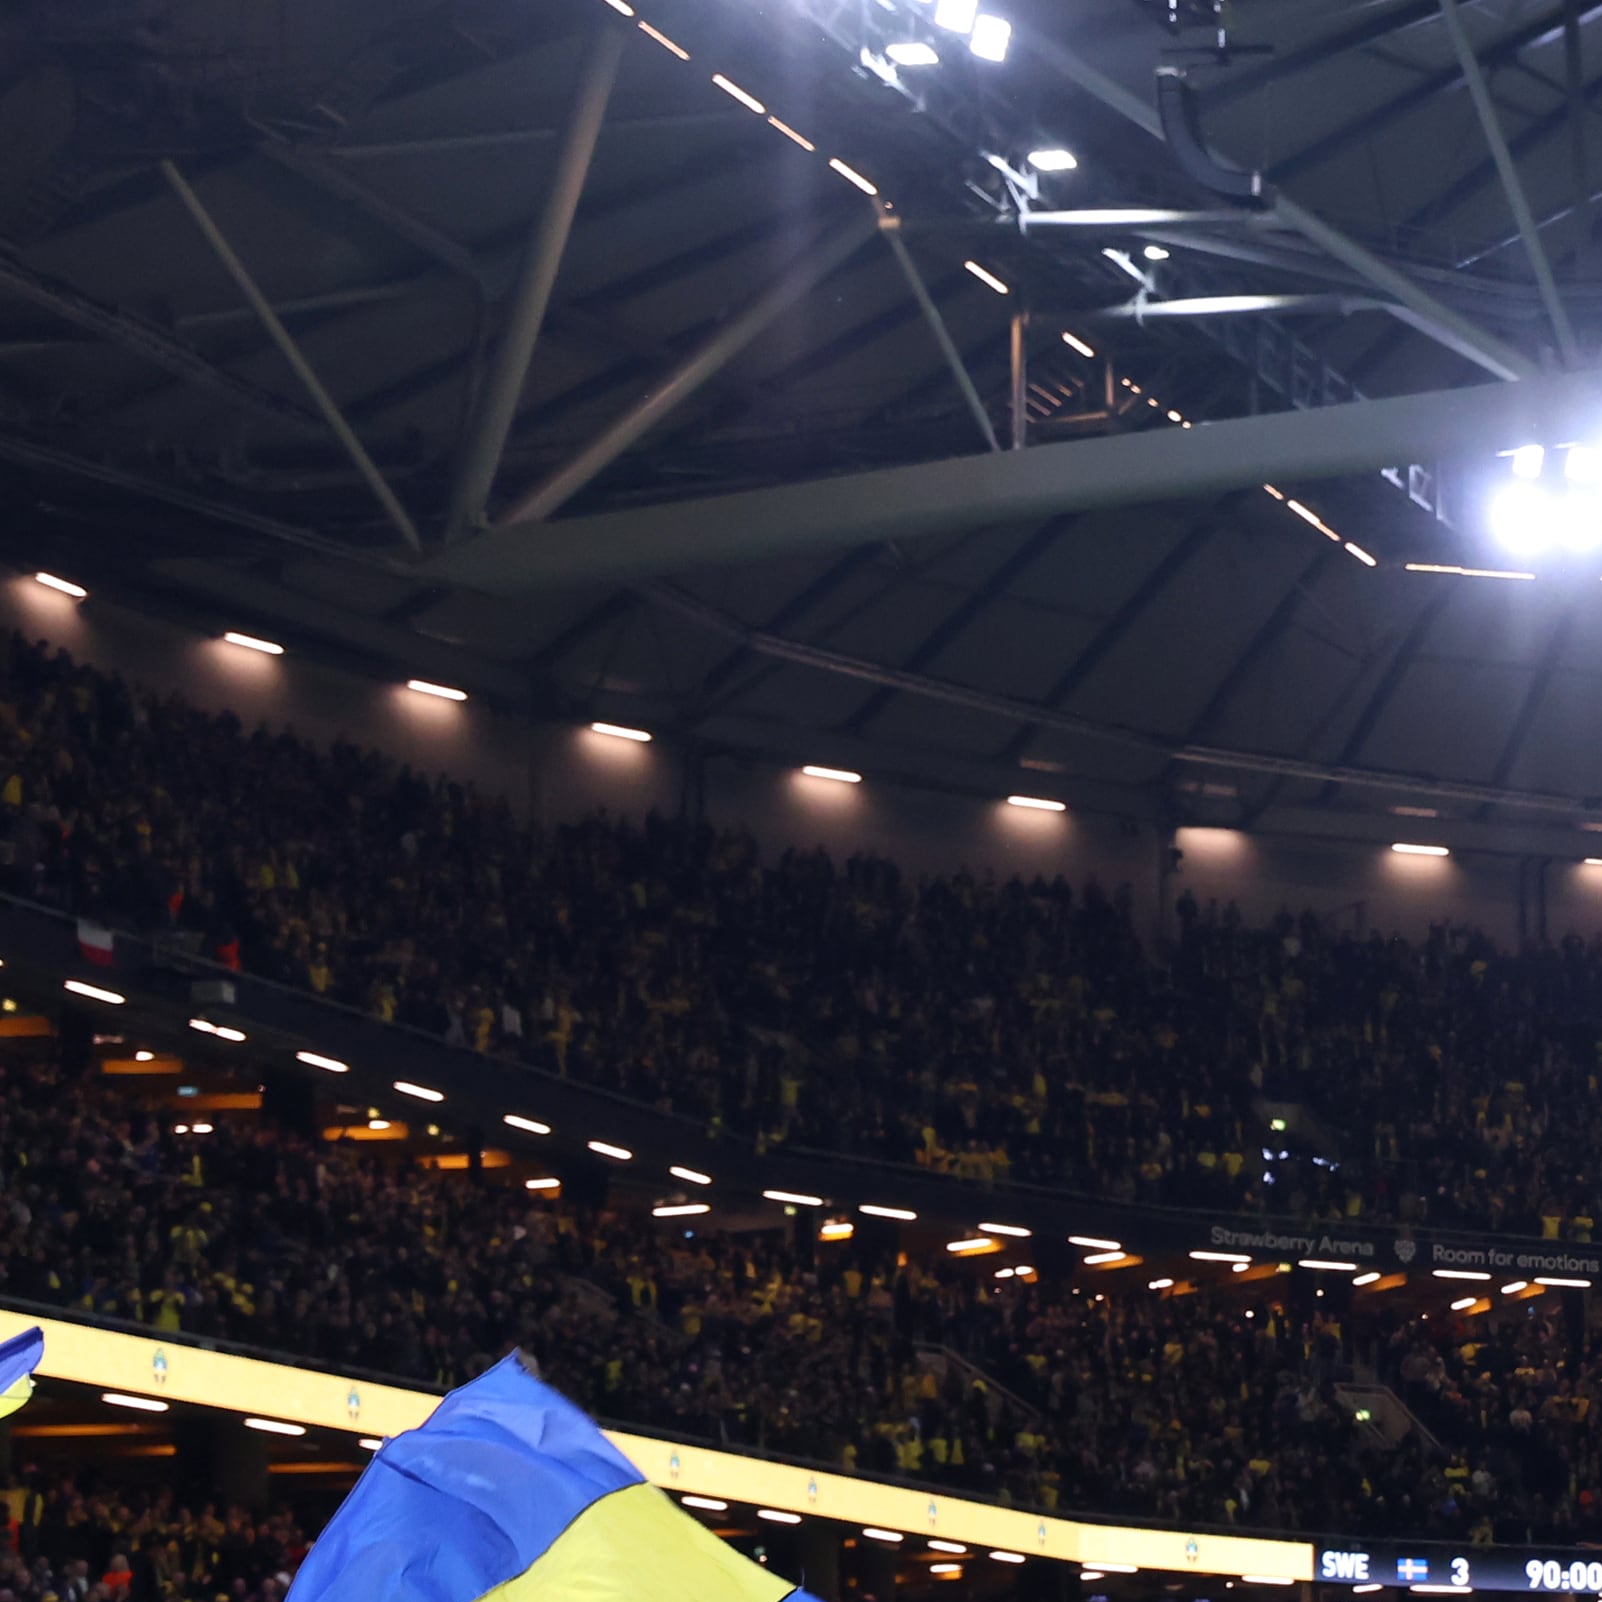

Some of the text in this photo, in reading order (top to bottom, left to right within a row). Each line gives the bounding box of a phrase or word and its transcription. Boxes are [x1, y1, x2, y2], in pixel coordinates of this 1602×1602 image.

[1211, 1227, 1374, 1256] Strawberry Arena
[1433, 1244, 1600, 1273] Room for emotions
[1322, 1551, 1370, 1580] SWE
[1450, 1557, 1470, 1586] 3
